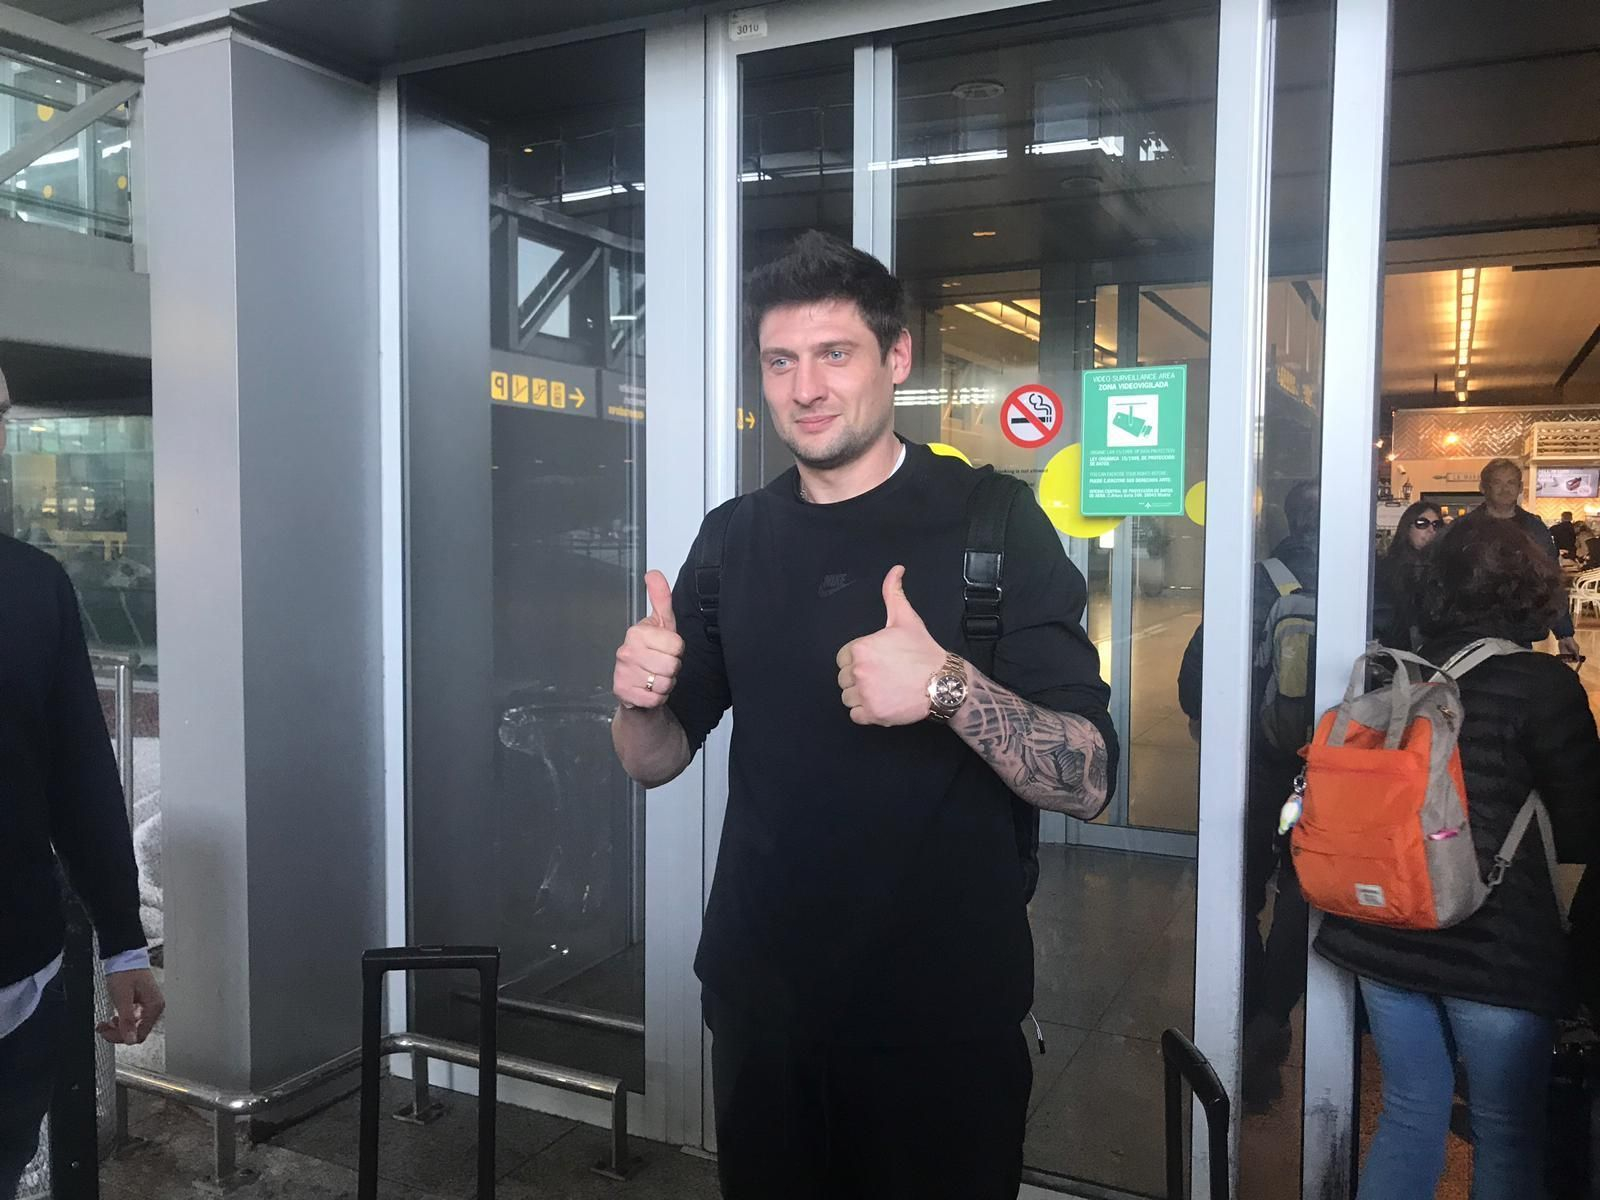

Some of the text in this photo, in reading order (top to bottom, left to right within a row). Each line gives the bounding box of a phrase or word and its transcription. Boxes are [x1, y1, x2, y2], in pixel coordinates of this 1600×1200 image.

[1093, 372, 1176, 383] VIDEO SURVEILLANCE AREA
[1098, 381, 1169, 391] ZONA VIDEOVIGILADA
